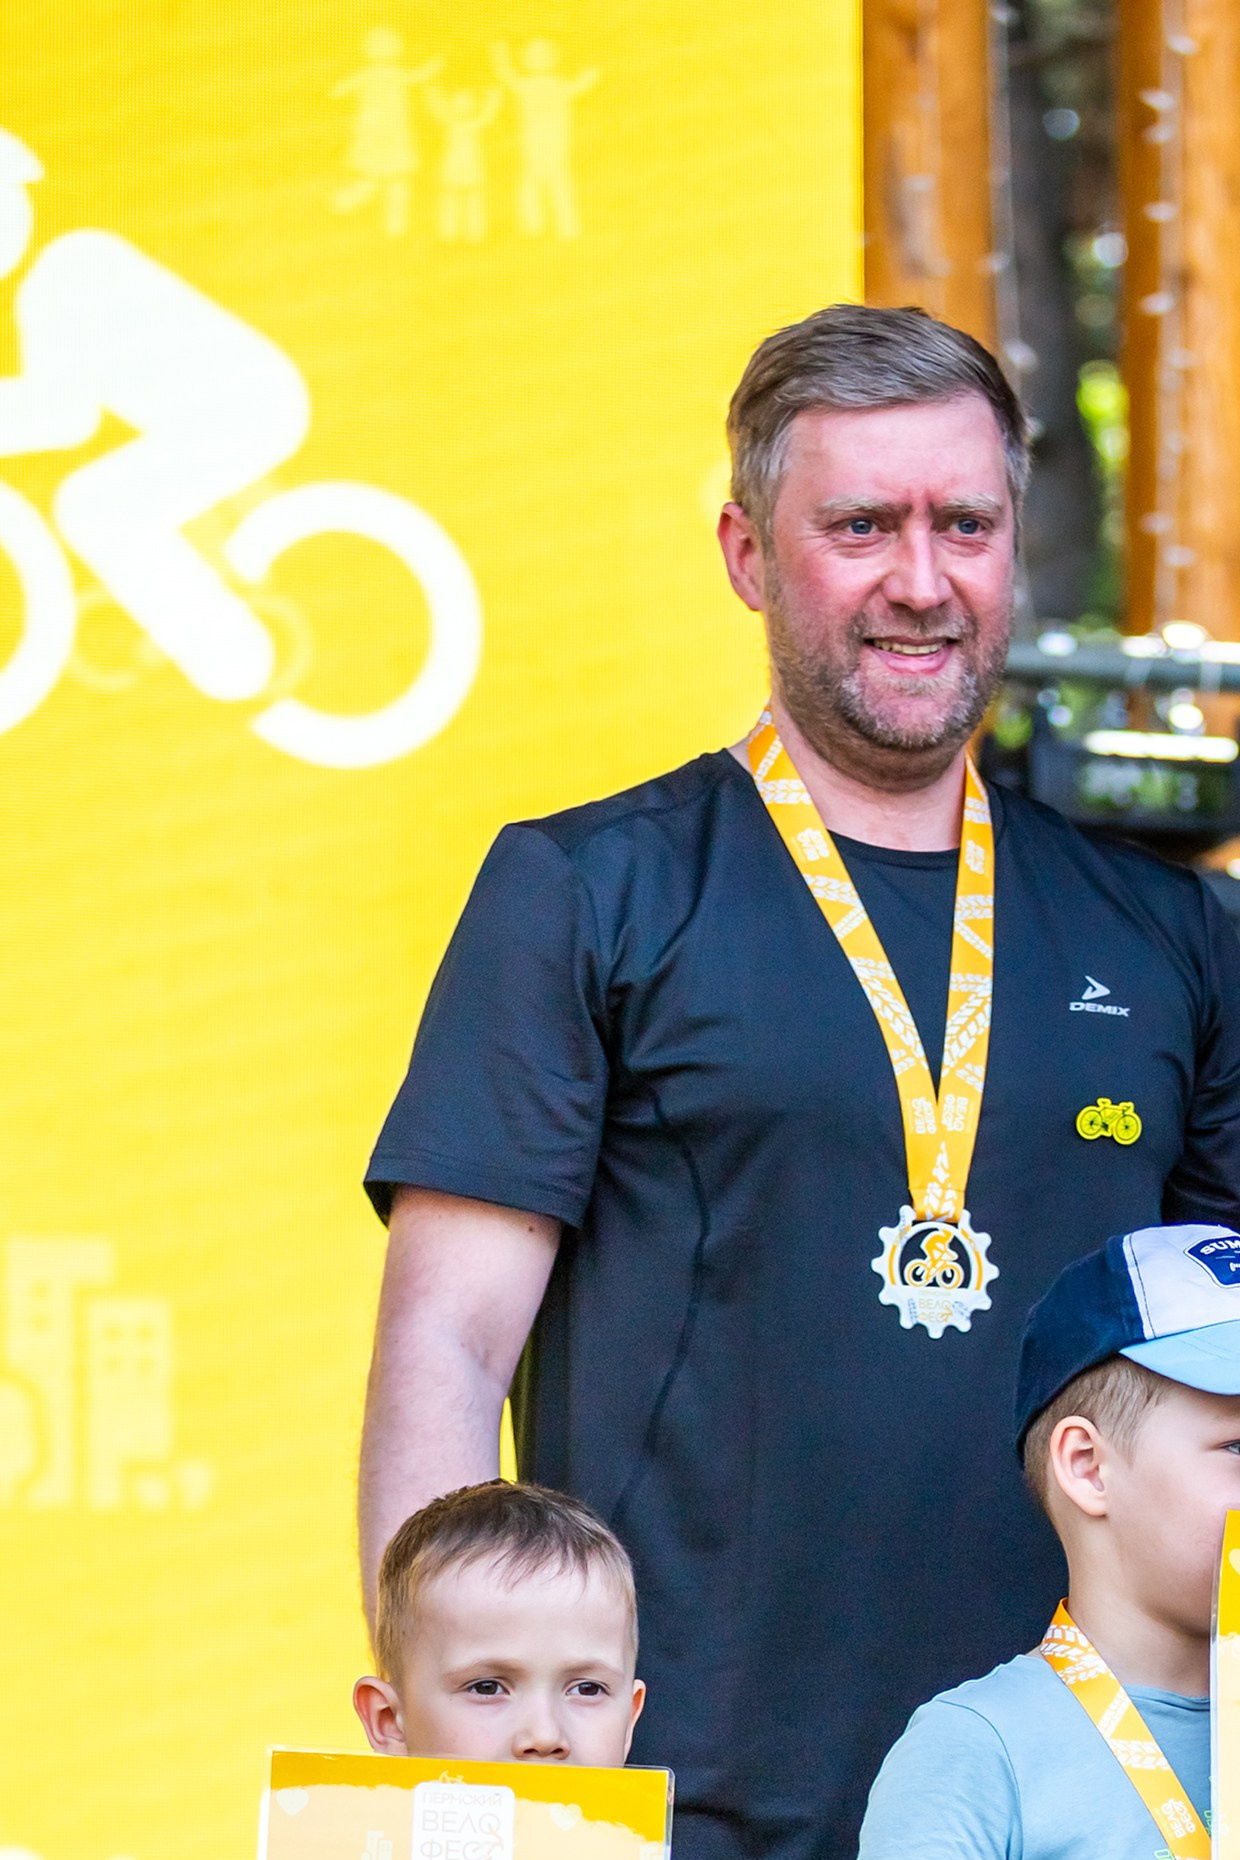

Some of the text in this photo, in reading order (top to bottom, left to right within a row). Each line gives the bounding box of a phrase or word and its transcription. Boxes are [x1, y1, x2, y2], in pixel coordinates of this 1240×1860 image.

[1069, 1001, 1131, 1017] DEMIX
[422, 1791, 503, 1807] ПЕРМСКИЙ
[421, 1810, 501, 1836] ВЕЛО
